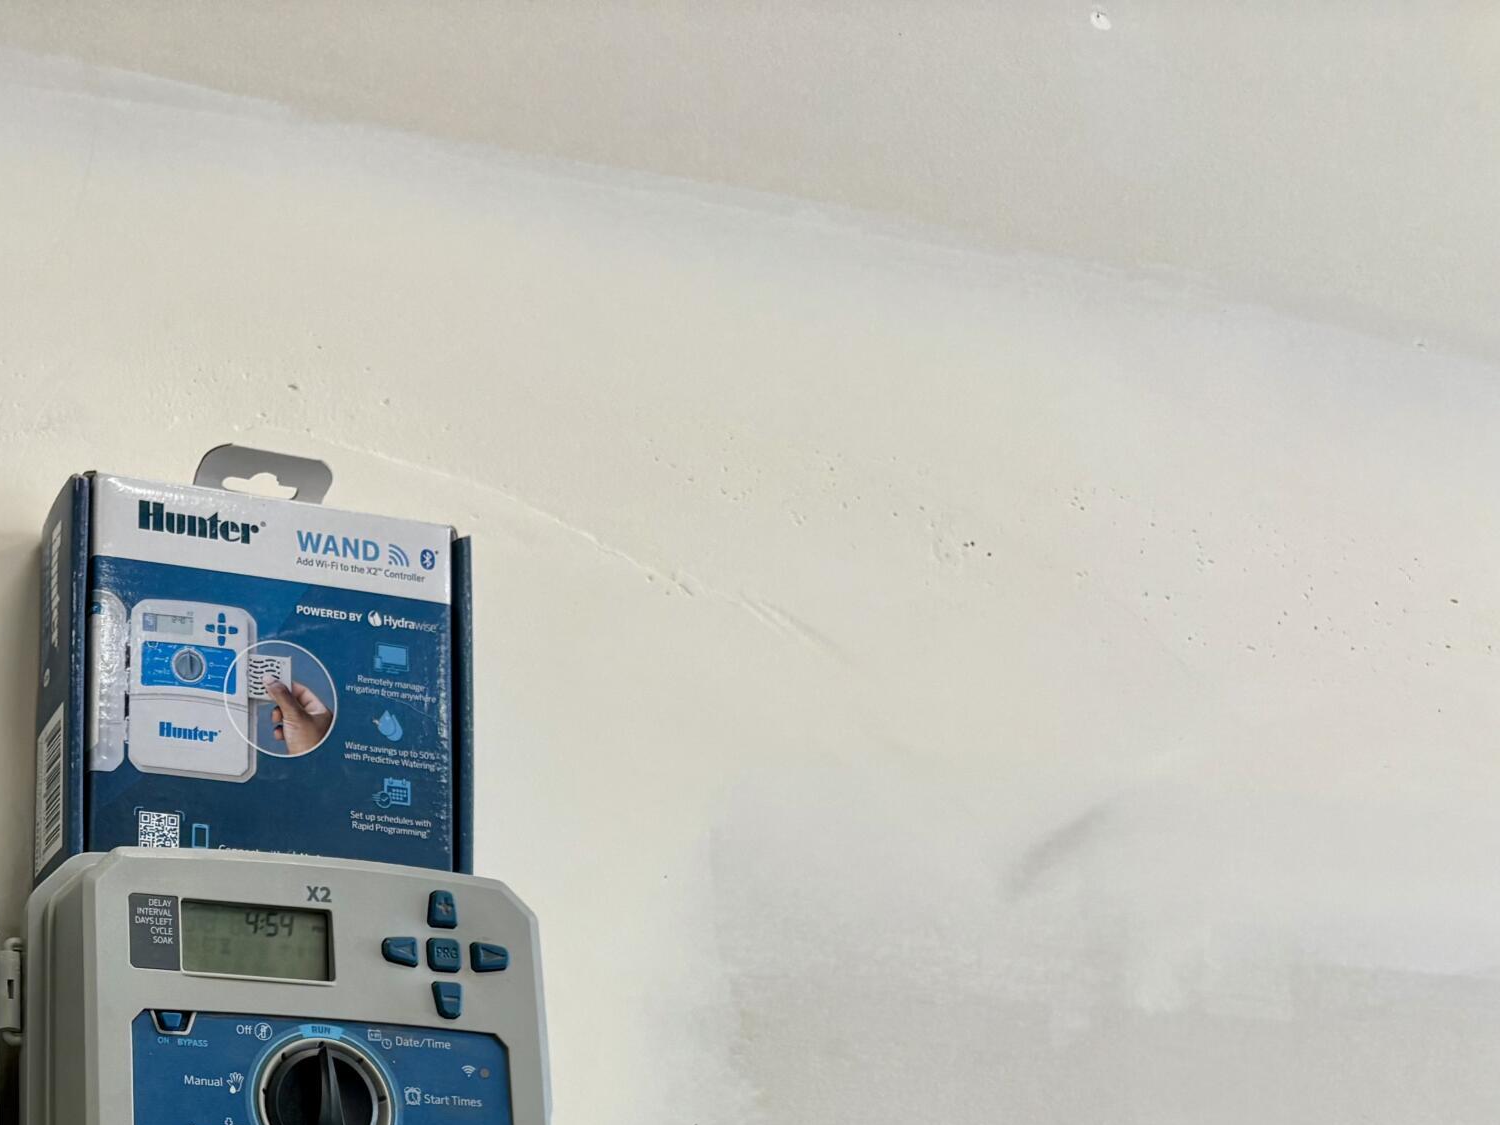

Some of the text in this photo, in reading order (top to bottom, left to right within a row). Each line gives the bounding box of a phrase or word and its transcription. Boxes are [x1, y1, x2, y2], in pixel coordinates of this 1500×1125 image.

[297, 530, 380, 561] WAND
[296, 557, 313, 567] Add
[316, 560, 339, 570] Wi-Fi
[340, 563, 349, 572] to
[350, 565, 364, 574] the
[384, 569, 425, 583] Controller
[296, 605, 363, 622] POWERED BY
[357, 674, 425, 692] Remotely manage
[345, 684, 436, 704] irrigation from anywhere
[345, 741, 418, 758] Water savings up to
[344, 752, 400, 766] with Predictive
[350, 810, 432, 827] Set up schedules with
[351, 821, 374, 831] Rapid
[306, 886, 333, 903] X2
[148, 898, 172, 907] DELAY
[136, 907, 172, 917] INTERVAL
[135, 916, 172, 926] DAYS LEFT
[245, 912, 294, 937] 4:54
[150, 927, 173, 935] CYCLE
[153, 936, 173, 945] SOAK
[436, 946, 458, 959] PRG
[236, 1024, 253, 1034] Off
[311, 1025, 331, 1034] RUN
[177, 1038, 209, 1048] BYPASS
[395, 1036, 451, 1050] Date/Time
[184, 1075, 223, 1087] Manual
[424, 1094, 482, 1108] Start Times
